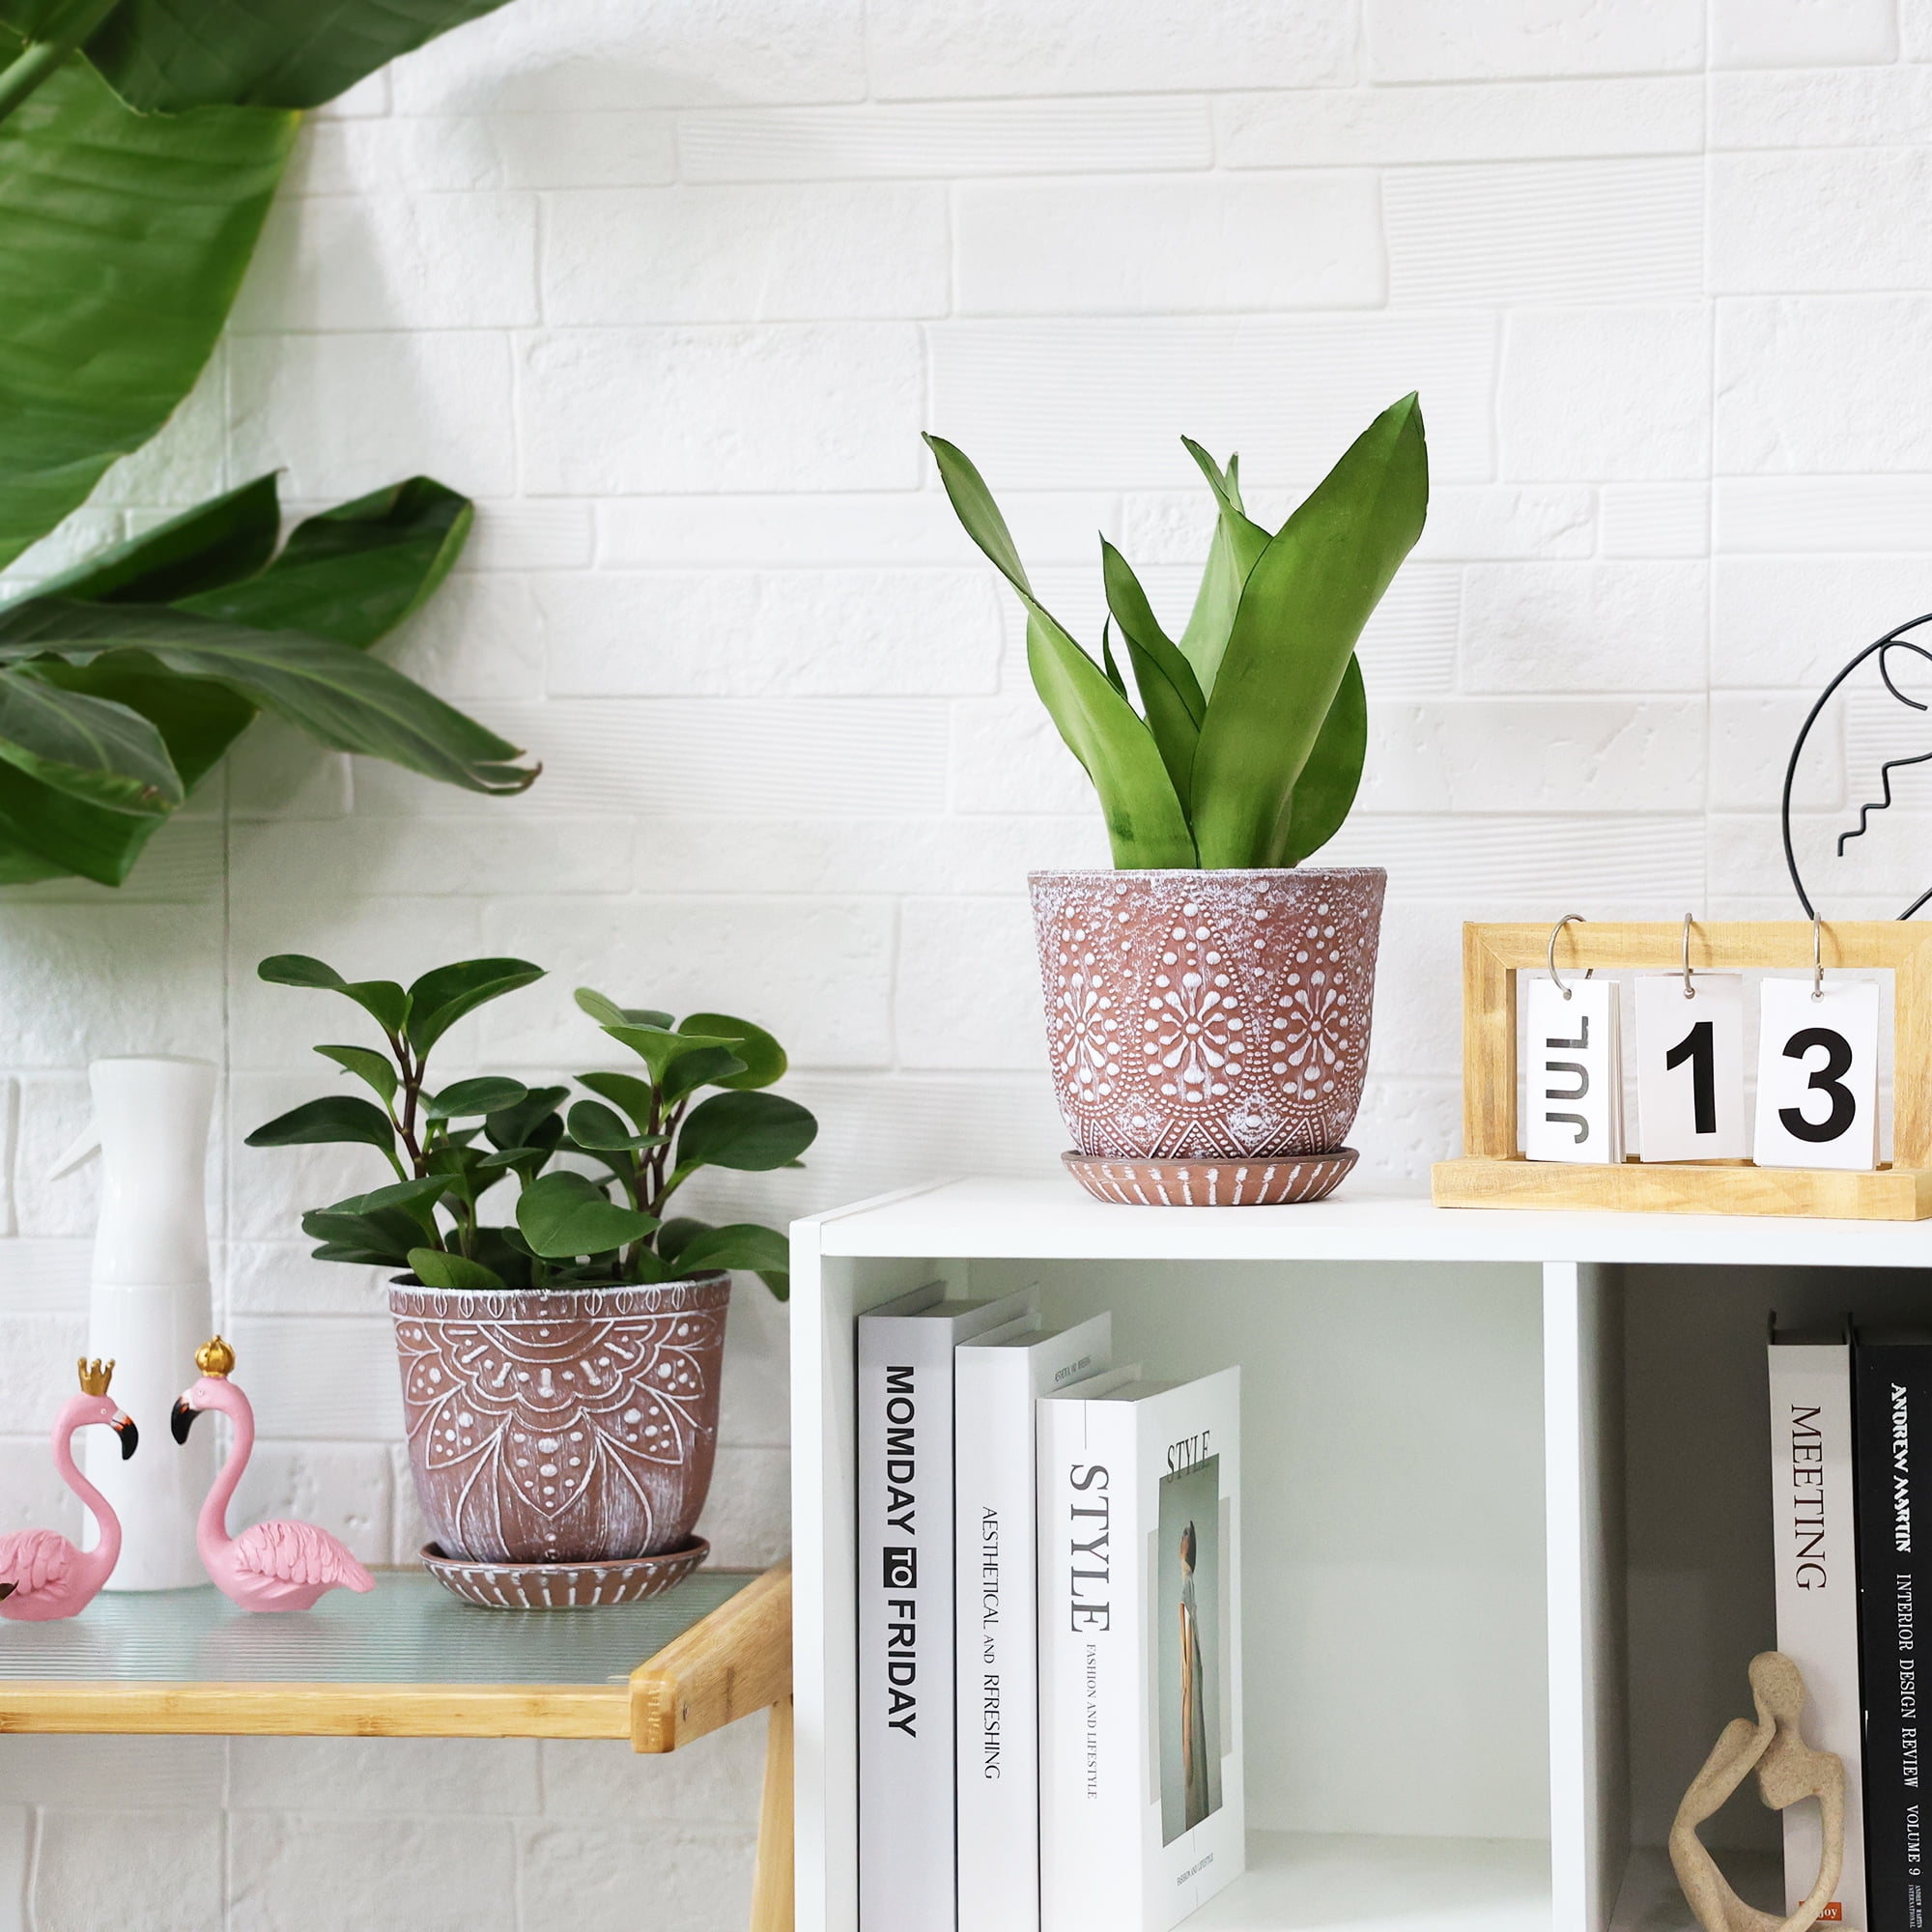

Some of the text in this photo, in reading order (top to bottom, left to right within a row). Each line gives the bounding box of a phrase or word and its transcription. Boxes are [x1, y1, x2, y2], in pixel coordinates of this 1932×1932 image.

[1545, 1015, 1590, 1145] JUL
[1665, 1021, 1857, 1144] 1 3
[1166, 1429, 1210, 1484] STYLE
[1791, 1404, 1827, 1592] MEETING
[886, 1365, 917, 1739] MOMDAY TO FRIDAY
[981, 1506, 999, 1630] AESTHETICAL
[983, 1634, 995, 1664] AND
[1070, 1464, 1110, 1800] STYLE FASHION AND LIFESTYLE
[1890, 1382, 1921, 1876] ANDREW MARTIN INTERIOR DESIGN REVIEW VOLUME 9
